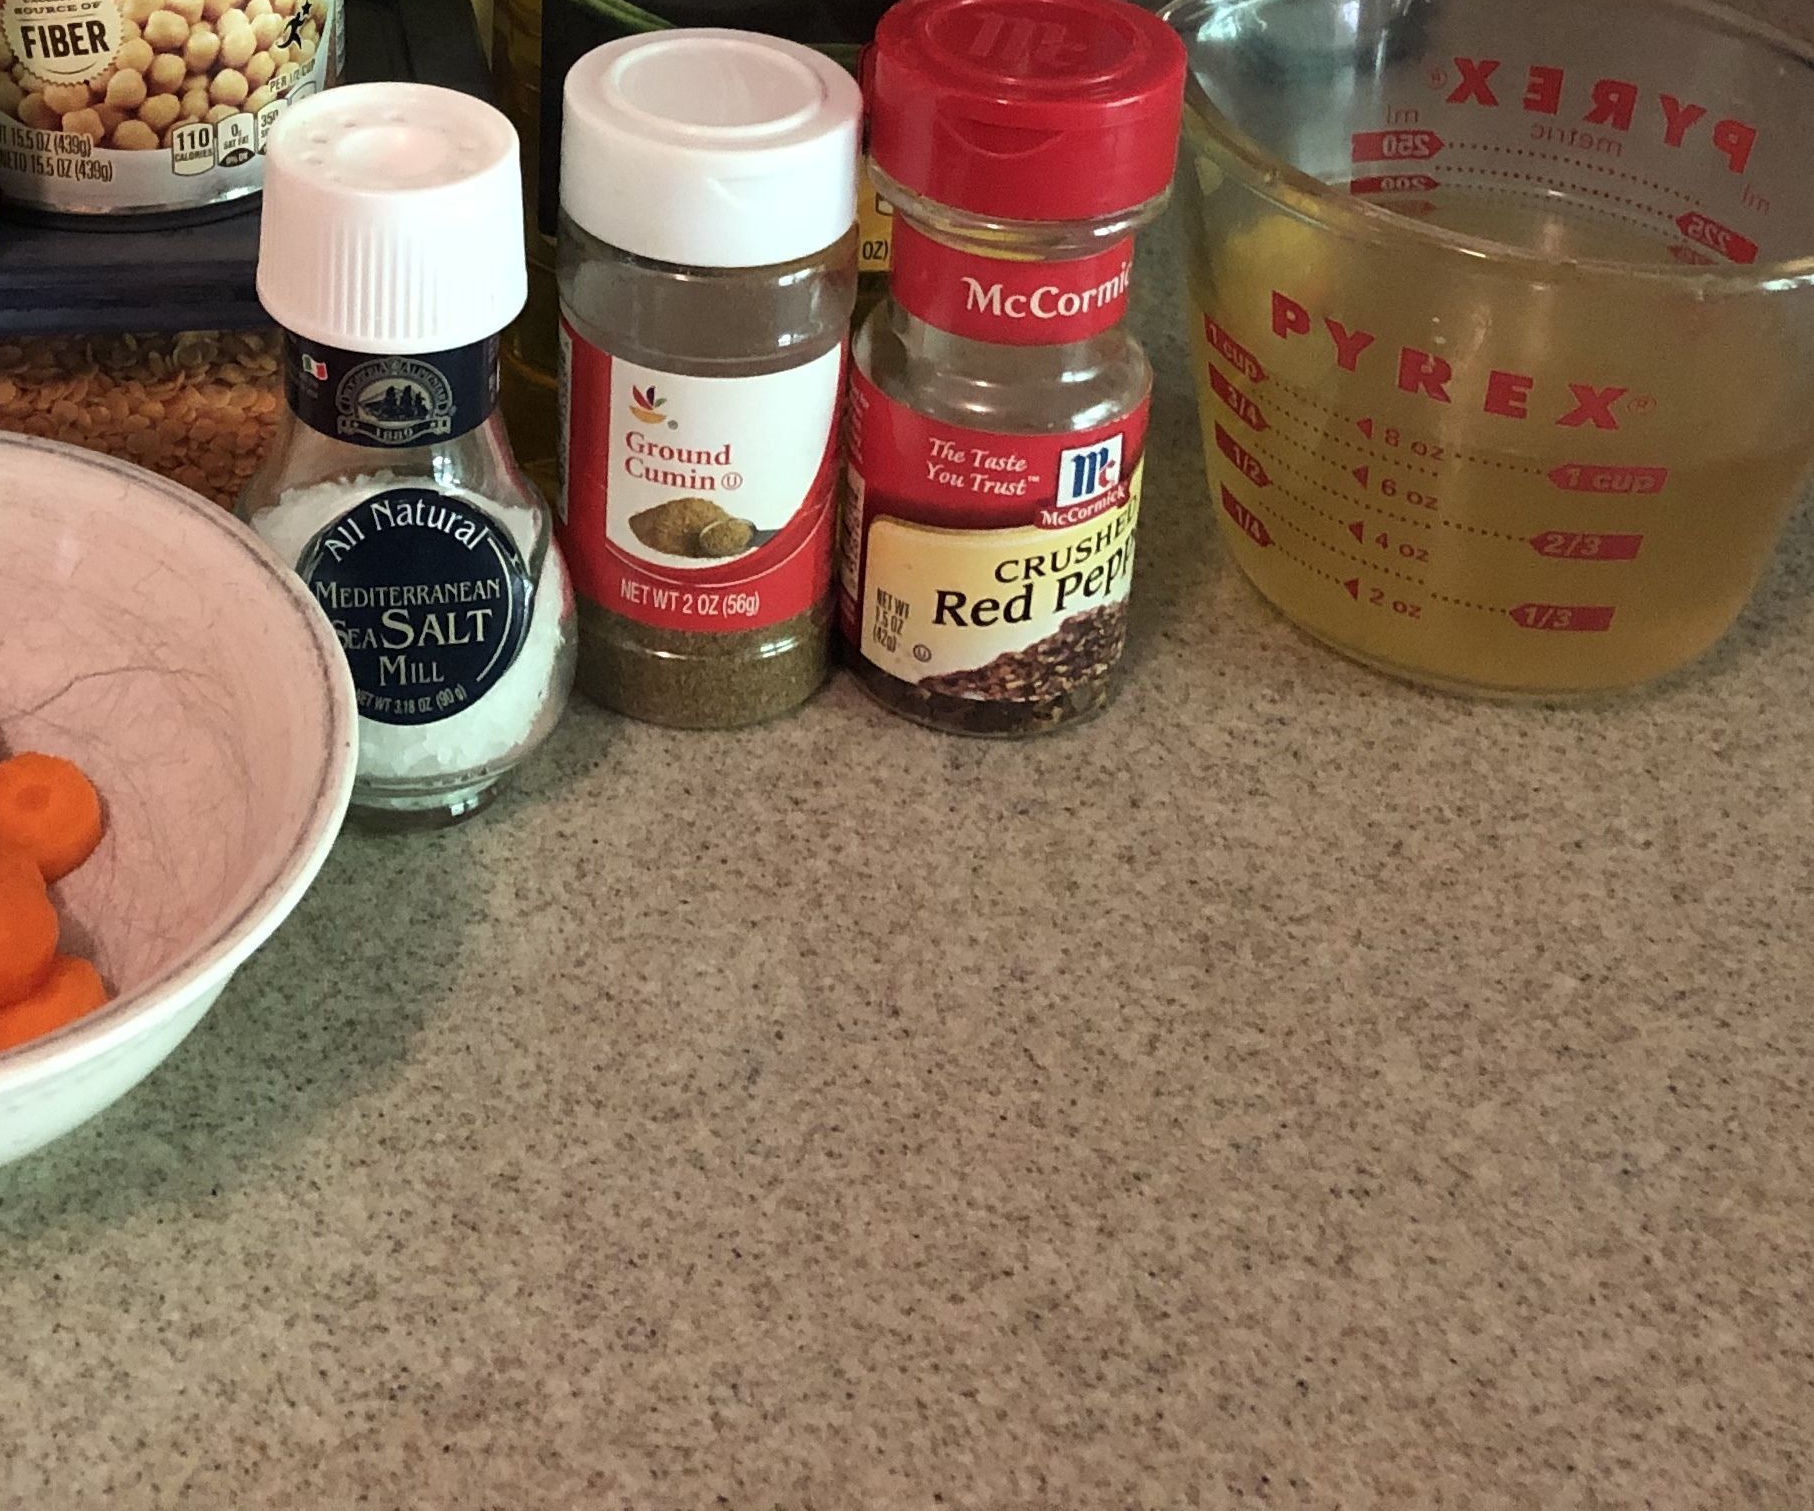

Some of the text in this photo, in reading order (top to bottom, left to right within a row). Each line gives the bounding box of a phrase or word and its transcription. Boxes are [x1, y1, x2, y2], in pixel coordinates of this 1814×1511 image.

[14, 5, 77, 14] SOURCE
[21, 20, 109, 58] FIBER
[11, 127, 91, 157] 15.5 OZ (439g)
[177, 128, 209, 151] 110
[31, 156, 54, 176] 15.5
[57, 159, 71, 179] OZ
[75, 161, 112, 182] (439g)
[175, 149, 212, 162] CALORIES
[863, 240, 888, 261] OZ)
[1271, 290, 1628, 430] PYREX
[1227, 385, 1258, 426] 3/4
[626, 431, 731, 465] Ground
[1384, 429, 1400, 447] 8
[929, 438, 1028, 473] The Taste
[1234, 447, 1263, 483] 1/2
[625, 457, 715, 490] Cumin
[927, 462, 964, 488] You
[1381, 477, 1397, 498] 6
[1041, 484, 1125, 526] McCormick
[324, 500, 488, 562] All Natural
[1237, 505, 1264, 542] 1/4
[995, 497, 1138, 584] CRUSHED
[1375, 532, 1389, 549] 4
[1543, 533, 1602, 556] 2/3
[316, 579, 501, 608] MEDITERRANEAN
[621, 579, 760, 618] NET WT 2 OZ (56g)
[877, 587, 909, 619] NET WT
[932, 584, 1033, 627] Red
[1369, 587, 1385, 607] 2
[332, 609, 493, 649] SEA SALT
[891, 616, 903, 635] OZ
[1522, 606, 1573, 628] 1/3
[379, 655, 444, 686] MILL
[375, 697, 391, 710] WT
[394, 700, 415, 714] 3.18
[419, 697, 432, 712] OZ
